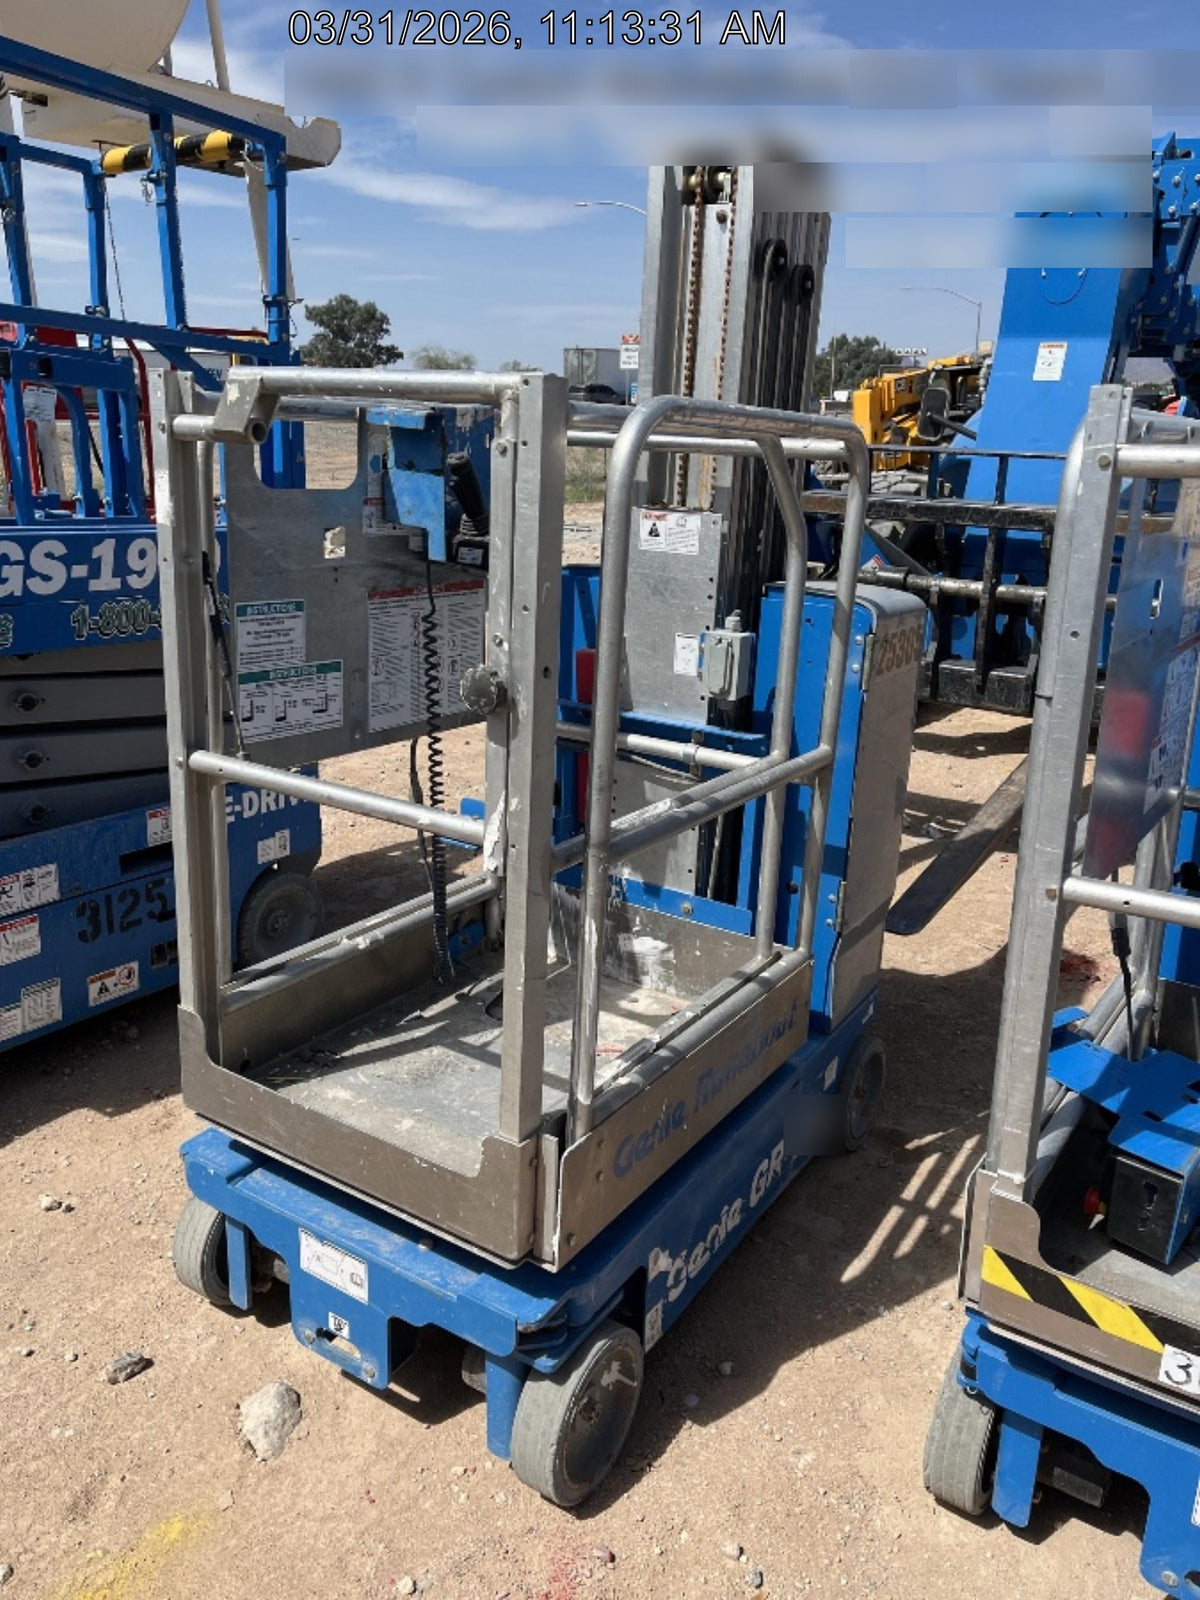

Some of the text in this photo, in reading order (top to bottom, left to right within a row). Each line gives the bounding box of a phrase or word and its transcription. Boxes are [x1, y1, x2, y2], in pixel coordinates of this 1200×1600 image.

[0, 537, 221, 597] GS-19
[71, 598, 161, 640] 1-800-
[225, 789, 308, 823] E-DRI
[613, 1100, 686, 1179] Genie
[1165, 1350, 1200, 1385] 3
